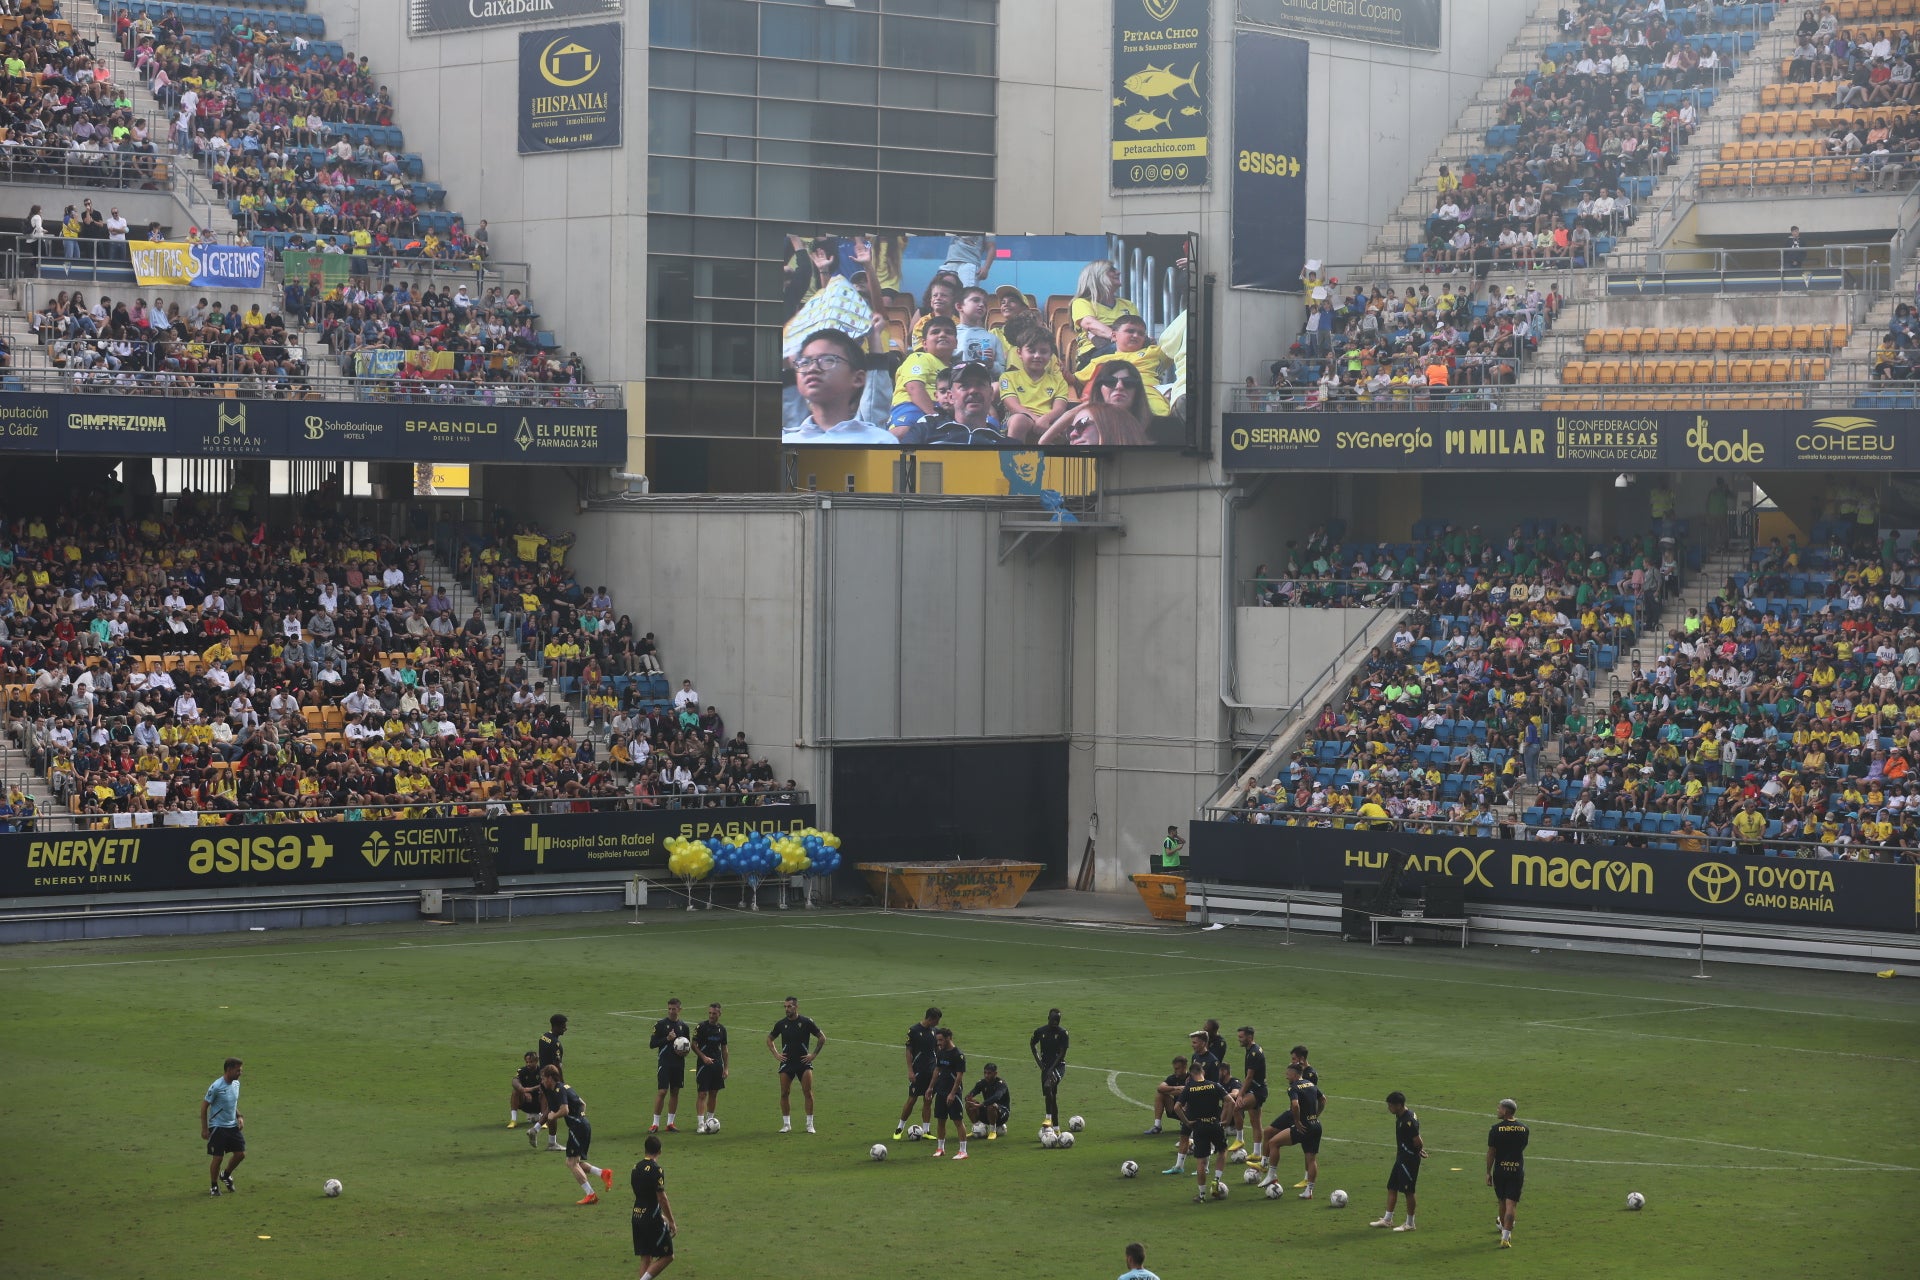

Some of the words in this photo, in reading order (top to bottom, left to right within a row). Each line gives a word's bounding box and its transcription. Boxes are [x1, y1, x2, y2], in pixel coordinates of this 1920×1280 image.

[1360, 0, 1402, 22] Copano
[536, 93, 604, 114] HISPANIA
[532, 120, 558, 128] servicios
[566, 116, 606, 126] inmobiliarios
[1124, 142, 1196, 156] petacachico.com
[1239, 150, 1287, 176] asisa
[209, 252, 260, 278] CREEMOS
[8, 423, 38, 436] Cádiz
[83, 414, 166, 431] IMPREZIONA
[405, 420, 497, 434] SPAGNOLO
[537, 424, 550, 436] EL
[553, 424, 598, 437] PUENTE
[1568, 416, 1658, 431] CONFEDERACIÓN
[203, 436, 261, 446] HOSMAN
[536, 438, 579, 448] FARMACIA
[581, 439, 598, 448] 24H
[1251, 428, 1320, 443] SERRANO
[1470, 429, 1545, 454] MILAR
[1568, 432, 1658, 445] EMPRESAS
[1796, 435, 1895, 451] COHEBU
[1568, 449, 1615, 459] PROVINCIA
[1617, 449, 1628, 459] DE
[1630, 447, 1657, 459] CÁDIZ
[395, 826, 499, 846] SCIENTIC
[680, 819, 804, 838] SPAGNOLO
[552, 835, 595, 850] Hospital
[598, 835, 618, 846] San
[621, 832, 655, 845] Rafael
[27, 836, 141, 872] ENERYETI
[188, 835, 301, 874] asisa
[587, 851, 622, 860] Hospitales
[623, 849, 650, 857] Pascual
[34, 876, 85, 886] ENERGY
[90, 874, 132, 884] DRINK
[1511, 854, 1653, 894] macron
[1744, 865, 1835, 893] TOYOTA
[1744, 892, 1787, 909] GAMO
[1790, 894, 1835, 913] BAHÍA
